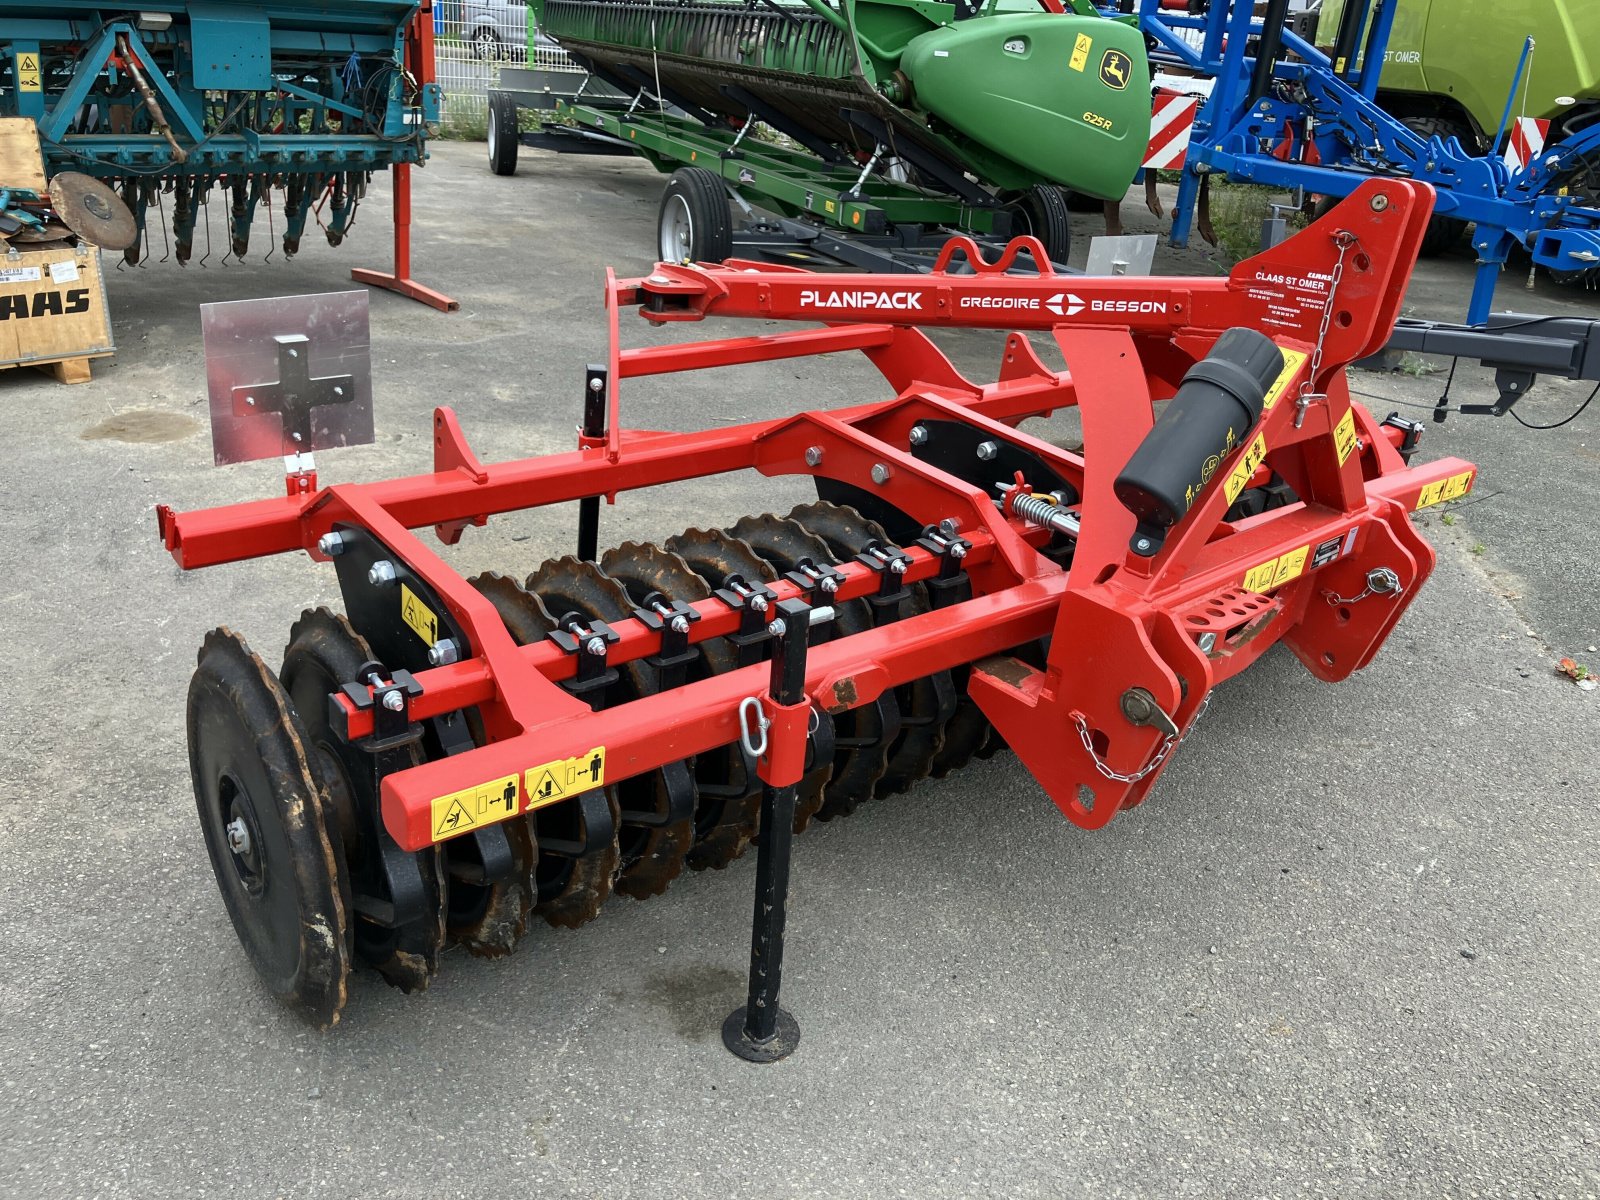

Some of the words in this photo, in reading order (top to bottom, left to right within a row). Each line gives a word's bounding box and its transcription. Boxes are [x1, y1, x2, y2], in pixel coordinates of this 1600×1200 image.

[1395, 51, 1421, 63] OMER
[1255, 271, 1284, 284] CLAAS
[1285, 276, 1298, 286] ST
[1298, 278, 1325, 290] OMER
[1307, 272, 1333, 281] CLAAS
[800, 290, 922, 310] PLANIPACK
[960, 296, 1041, 309] GRÉGOIRE
[1091, 300, 1167, 314] BESSON
